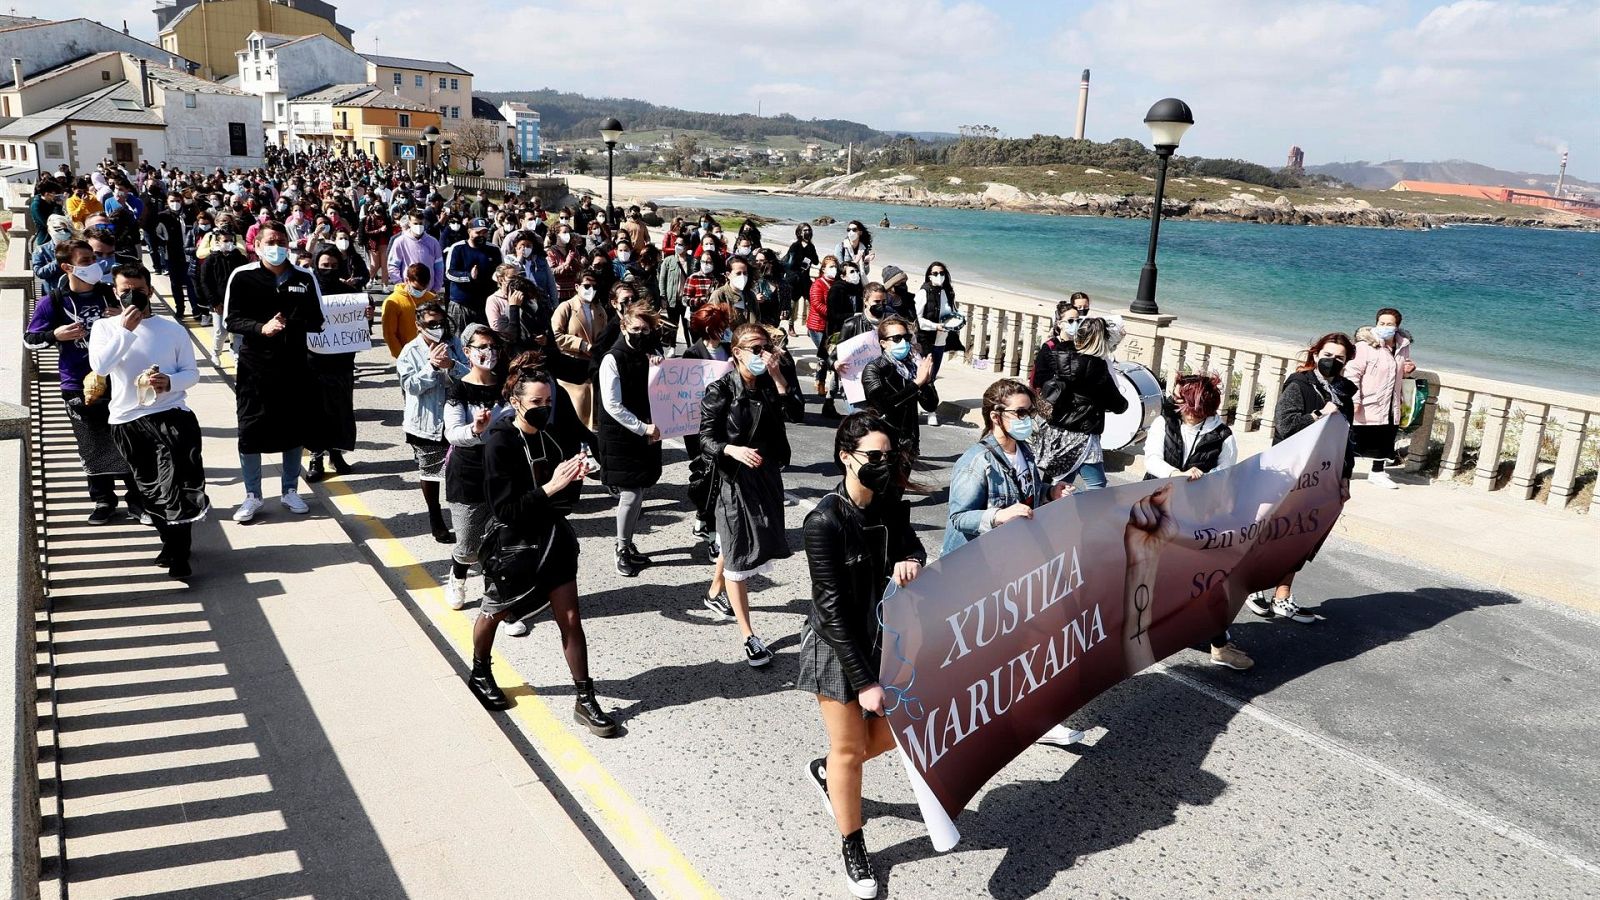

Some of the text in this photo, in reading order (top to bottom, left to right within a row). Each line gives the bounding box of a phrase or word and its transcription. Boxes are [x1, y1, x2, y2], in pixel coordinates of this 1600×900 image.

[656, 363, 716, 386] ASUSTA
[672, 402, 701, 422] ME
[940, 546, 1084, 668] XUSTIZA
[903, 603, 1108, 773] MARUXAINA
